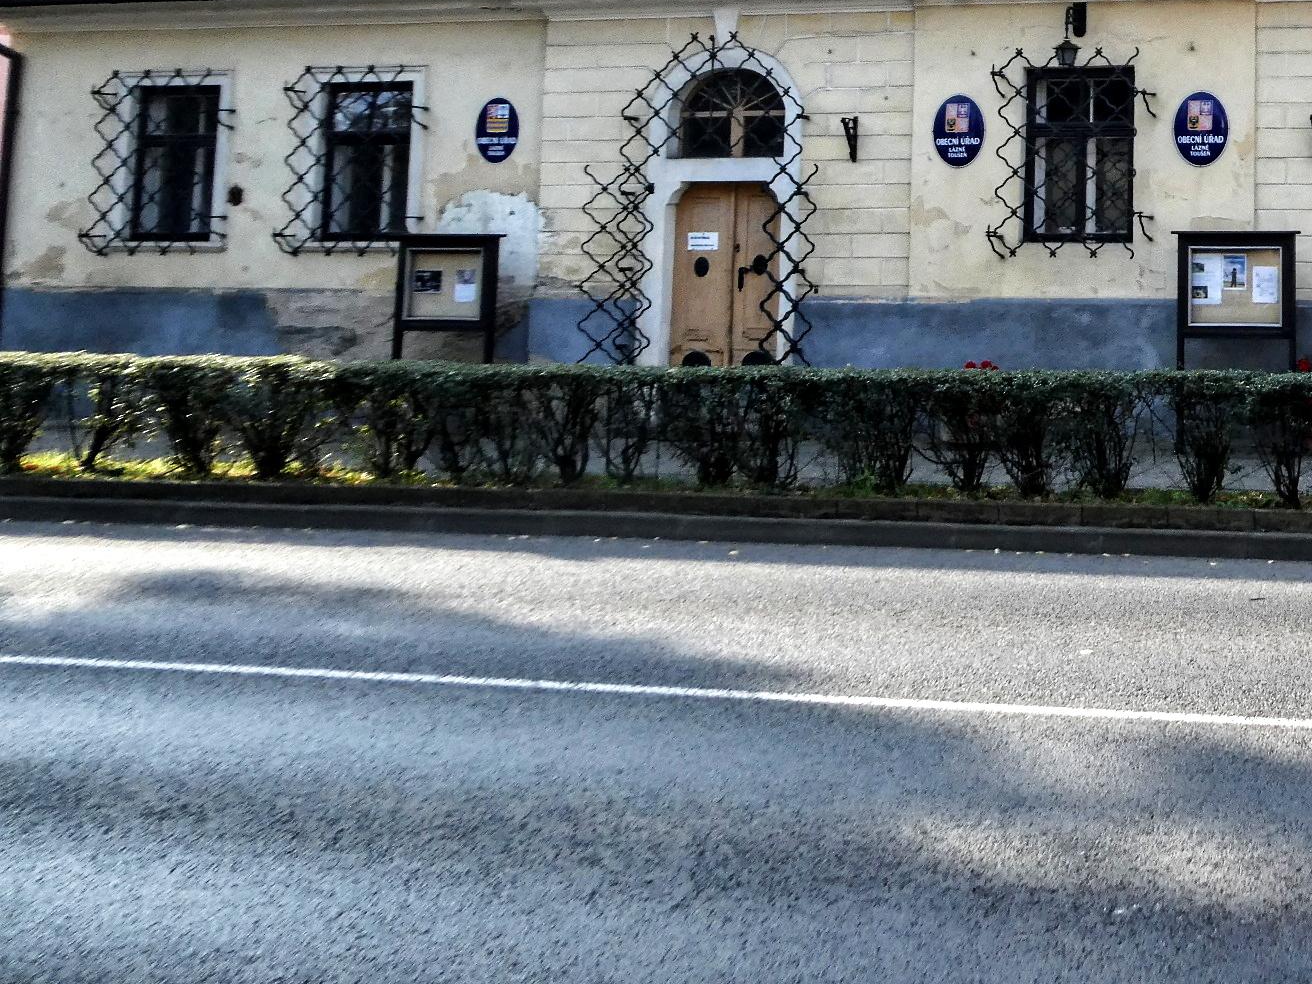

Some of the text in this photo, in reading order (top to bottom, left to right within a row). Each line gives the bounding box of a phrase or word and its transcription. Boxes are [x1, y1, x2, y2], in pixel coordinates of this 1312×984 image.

[936, 135, 980, 146] OBECNÍ ÚŘAD
[1177, 133, 1224, 143] OBECNÍ ÚŘAD
